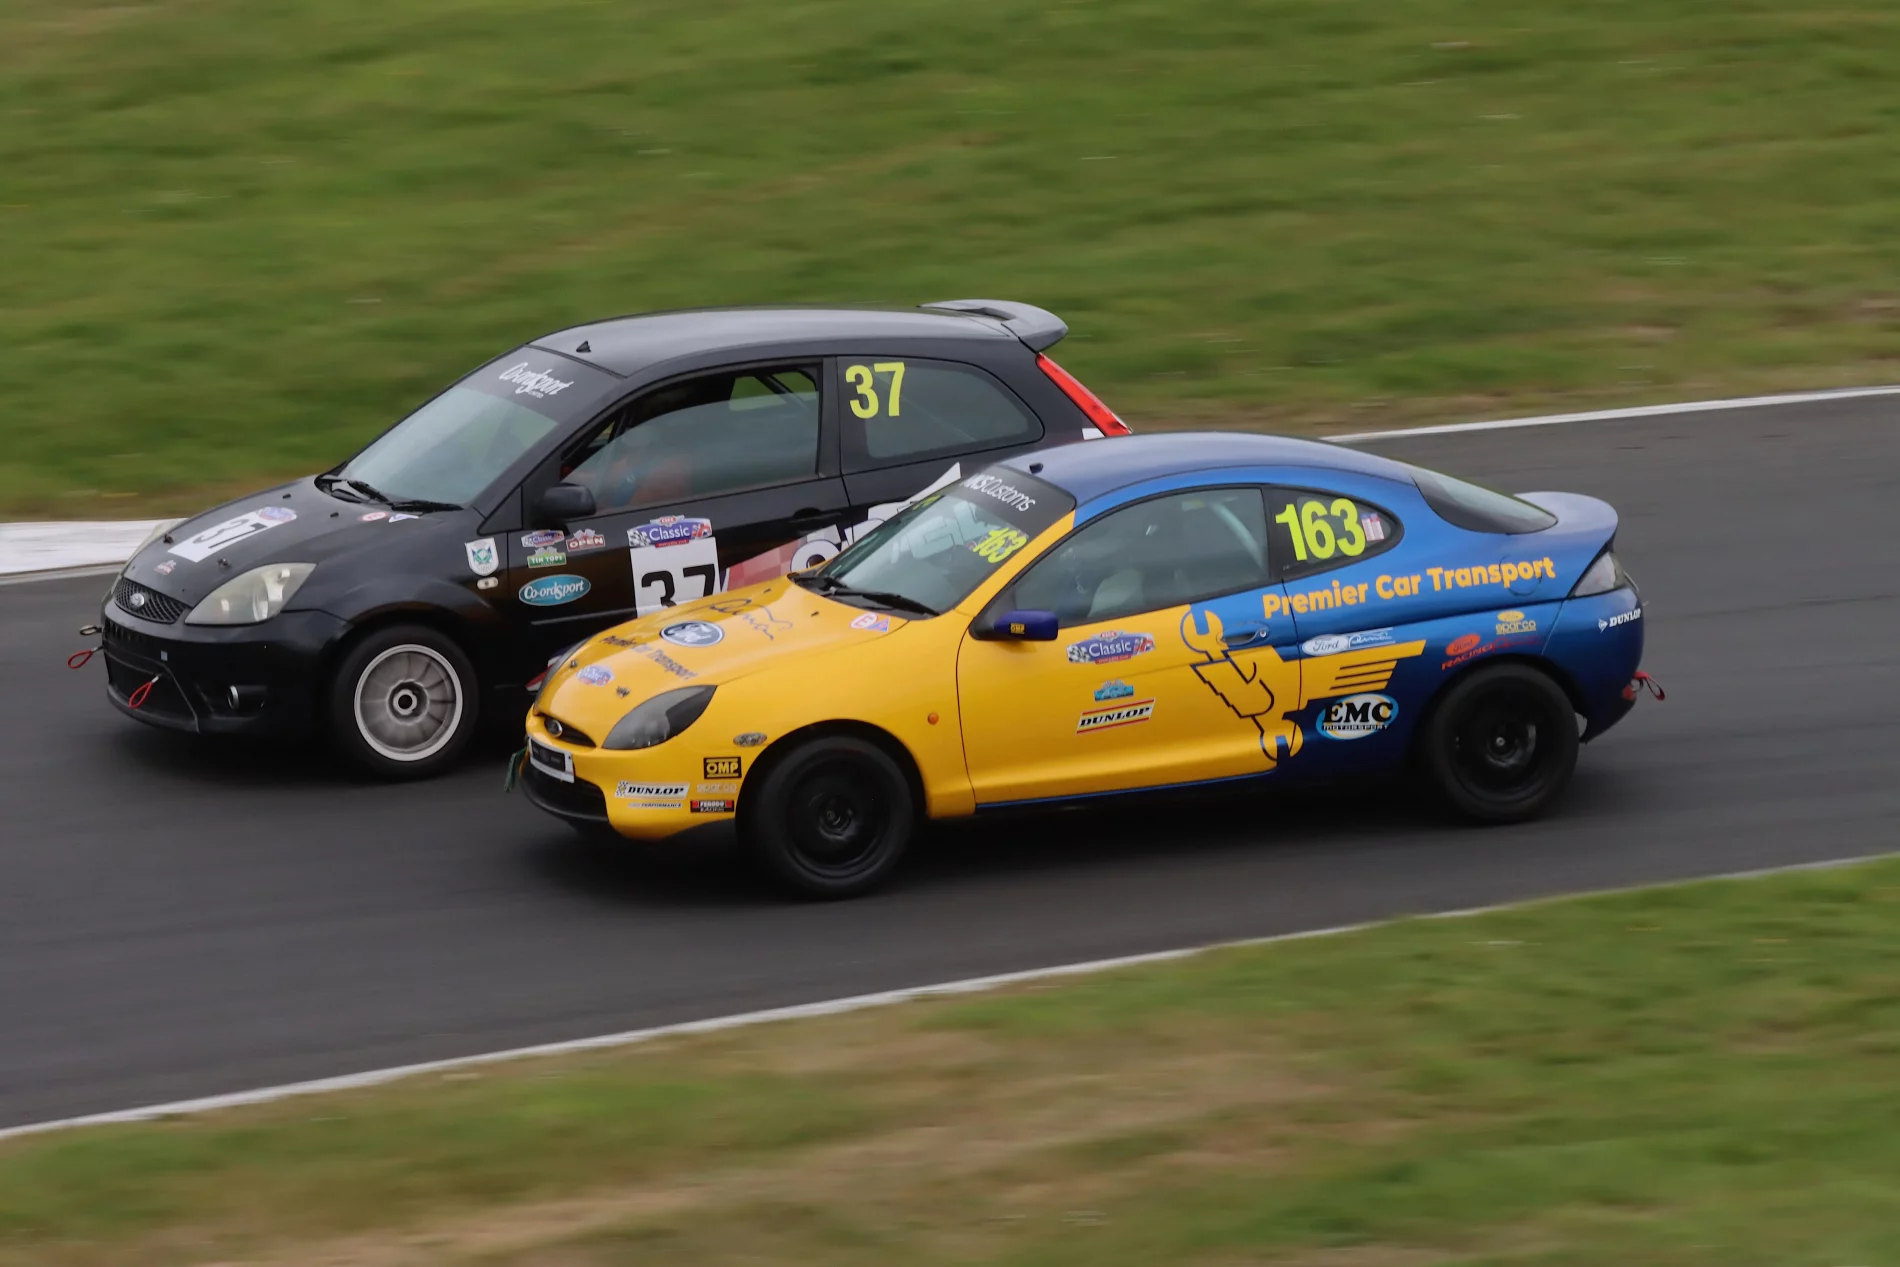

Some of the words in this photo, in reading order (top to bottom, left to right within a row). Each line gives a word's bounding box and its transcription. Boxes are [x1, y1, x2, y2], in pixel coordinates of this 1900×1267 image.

[846, 362, 905, 419] 37
[192, 518, 267, 549] 37
[649, 525, 690, 541] Classic
[1276, 498, 1366, 561] 163
[569, 537, 603, 549] OPEN
[973, 528, 1027, 563] 163
[531, 556, 544, 564] TIN
[546, 554, 562, 562] TOPS
[641, 563, 715, 608] 37
[1262, 580, 1369, 619] Premier
[1375, 573, 1422, 600] Car
[1426, 557, 1556, 590] Transport
[1609, 608, 1641, 628] DUNLOP
[1088, 640, 1132, 657] Classic
[1312, 639, 1340, 653] Ford
[1079, 706, 1150, 727] DUNLOP
[1322, 702, 1394, 723] EMC
[706, 762, 739, 774] OMP
[628, 786, 684, 795] DUNLOP
